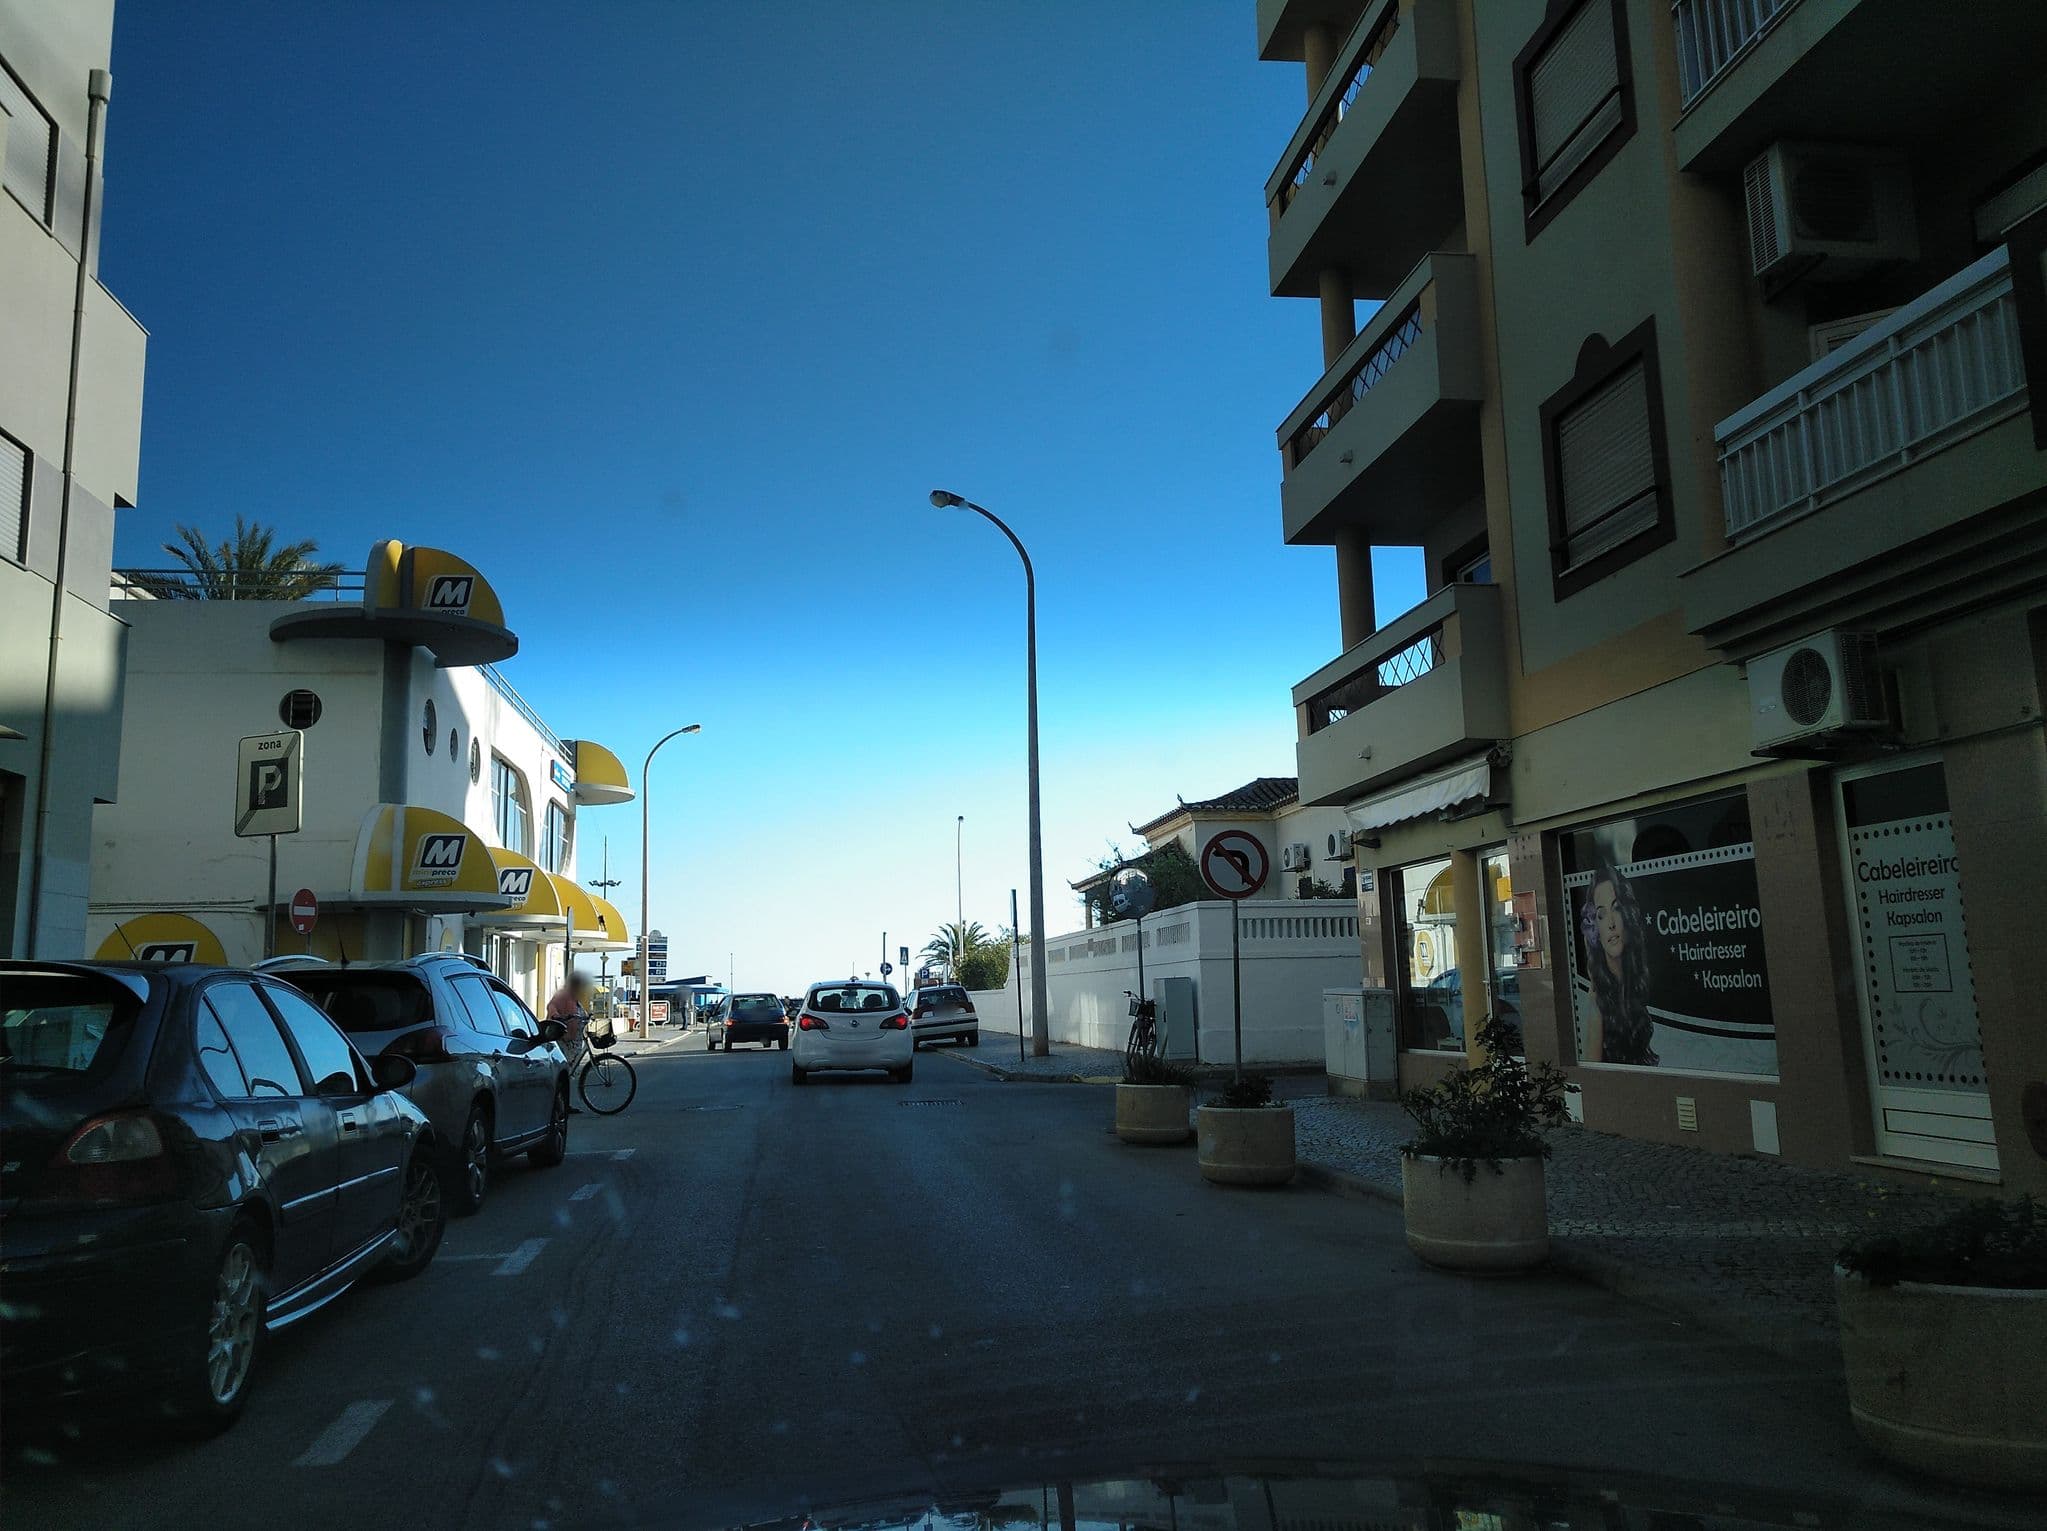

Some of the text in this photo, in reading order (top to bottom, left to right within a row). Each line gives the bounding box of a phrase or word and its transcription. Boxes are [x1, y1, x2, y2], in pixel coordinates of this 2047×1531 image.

[433, 580, 469, 605] M
[257, 740, 282, 751] zona
[257, 764, 282, 805] P
[424, 839, 461, 865] M
[1857, 853, 1961, 883] Cabeleireiro
[501, 872, 529, 893] M
[1879, 887, 1946, 905] Hairdresser
[1656, 903, 1761, 936] Cabeleireiro
[1886, 908, 1943, 928] Kapsalon
[1678, 941, 1747, 961] Hairdresser
[1702, 968, 1762, 992] Kapsalon
